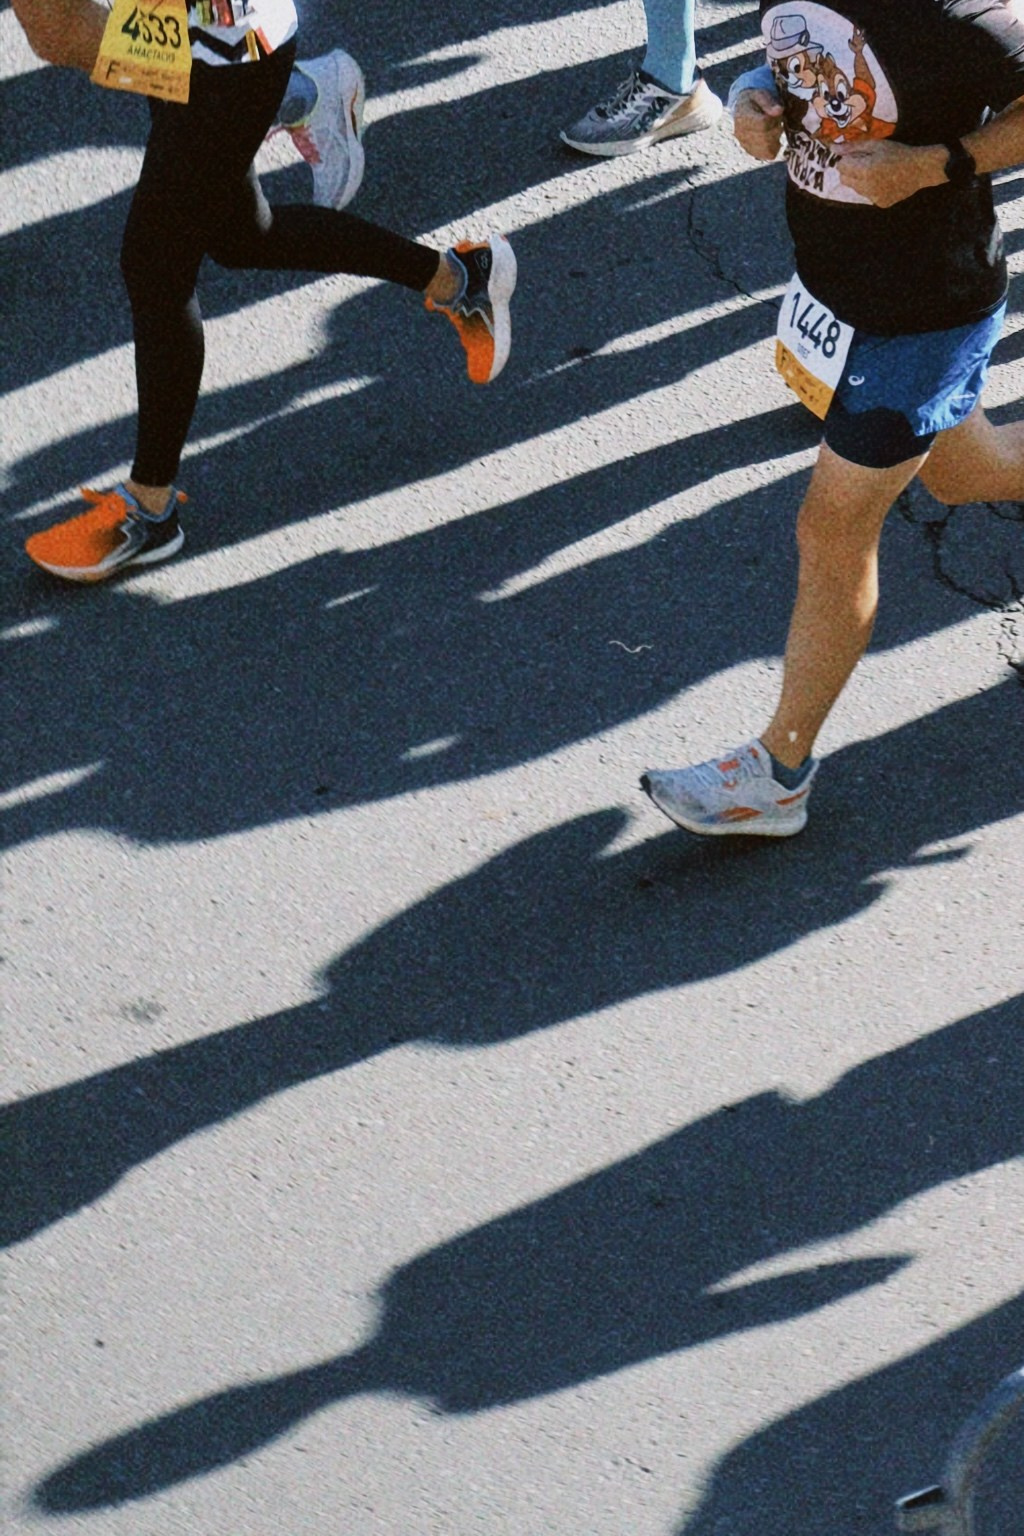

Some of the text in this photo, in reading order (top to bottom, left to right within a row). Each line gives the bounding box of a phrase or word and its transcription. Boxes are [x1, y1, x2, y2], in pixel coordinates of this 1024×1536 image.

[121, 5, 182, 50] 4533
[105, 59, 121, 81] F
[789, 292, 841, 359] 1448
